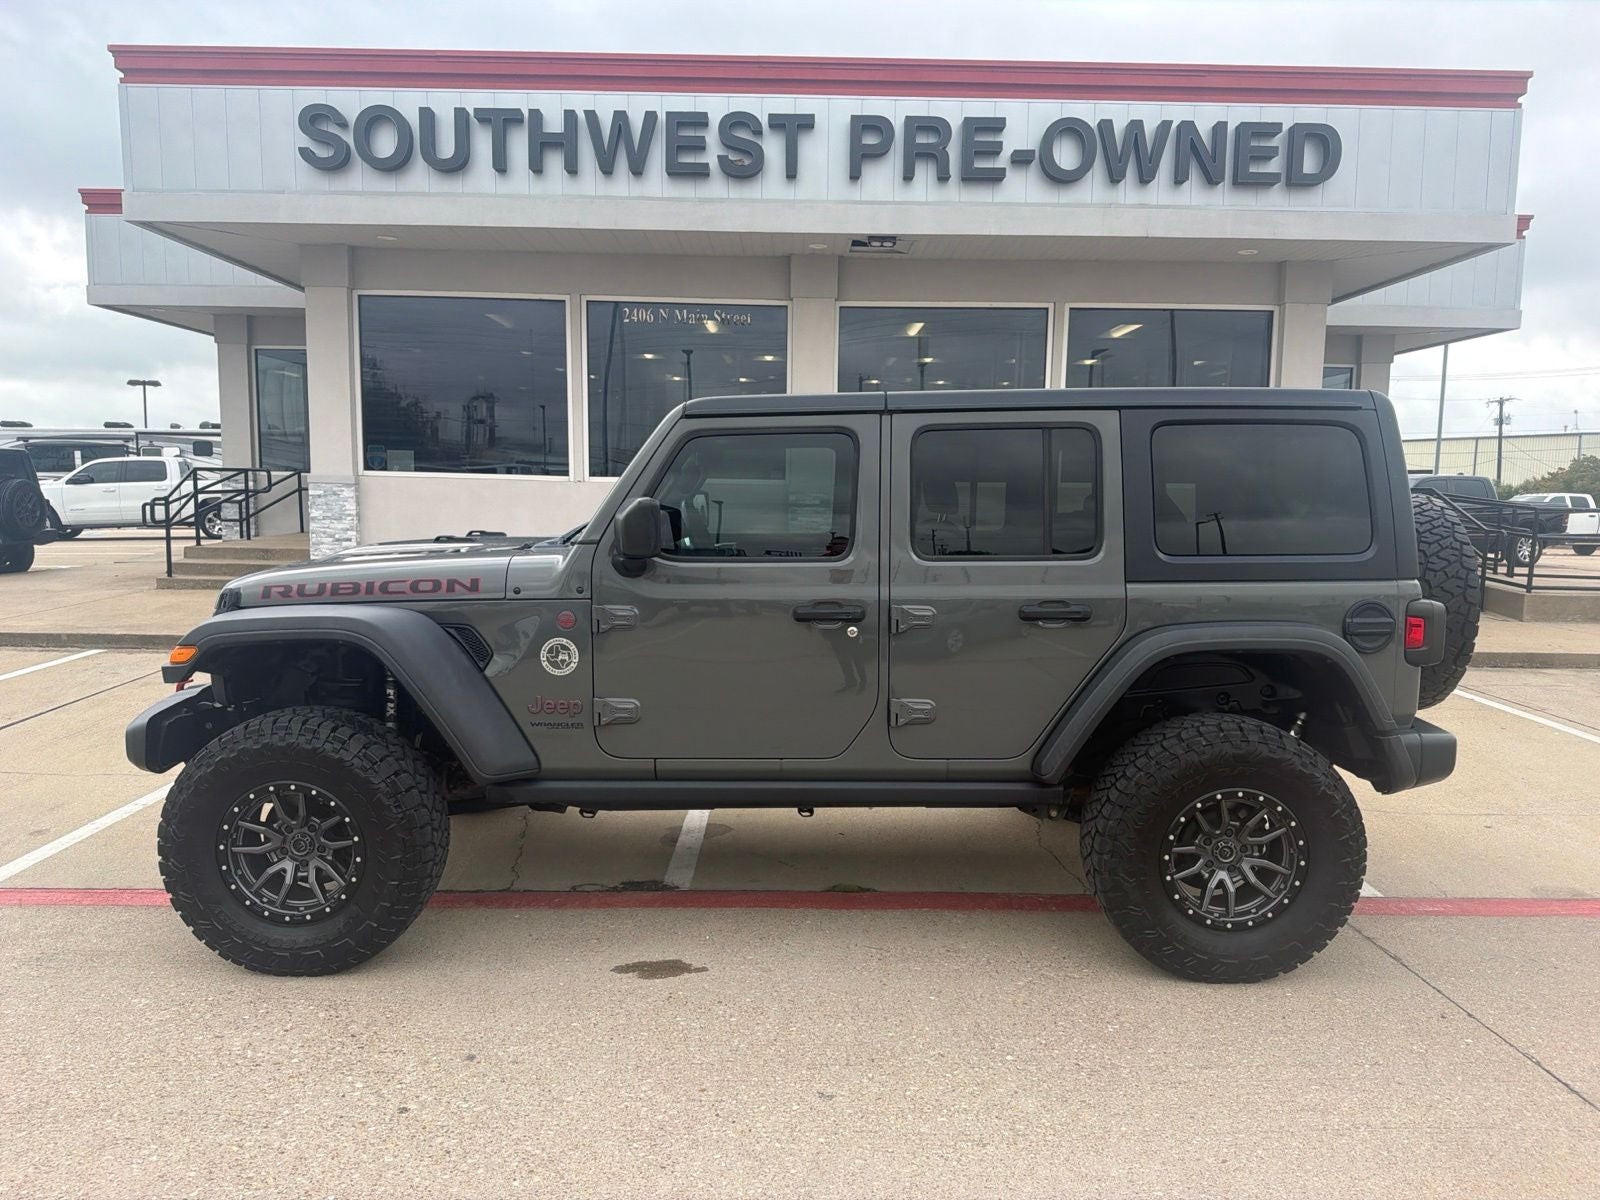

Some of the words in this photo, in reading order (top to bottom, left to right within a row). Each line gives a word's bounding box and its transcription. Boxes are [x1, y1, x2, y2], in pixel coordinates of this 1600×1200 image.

[298, 103, 815, 179] SOUTHWEST
[849, 114, 1342, 187] PRE-OWNED
[623, 307, 654, 323] 2406
[659, 308, 669, 324] N
[674, 308, 708, 324] Main
[713, 309, 752, 326] Street
[260, 578, 481, 599] RUBICON
[528, 696, 583, 717] Jeep
